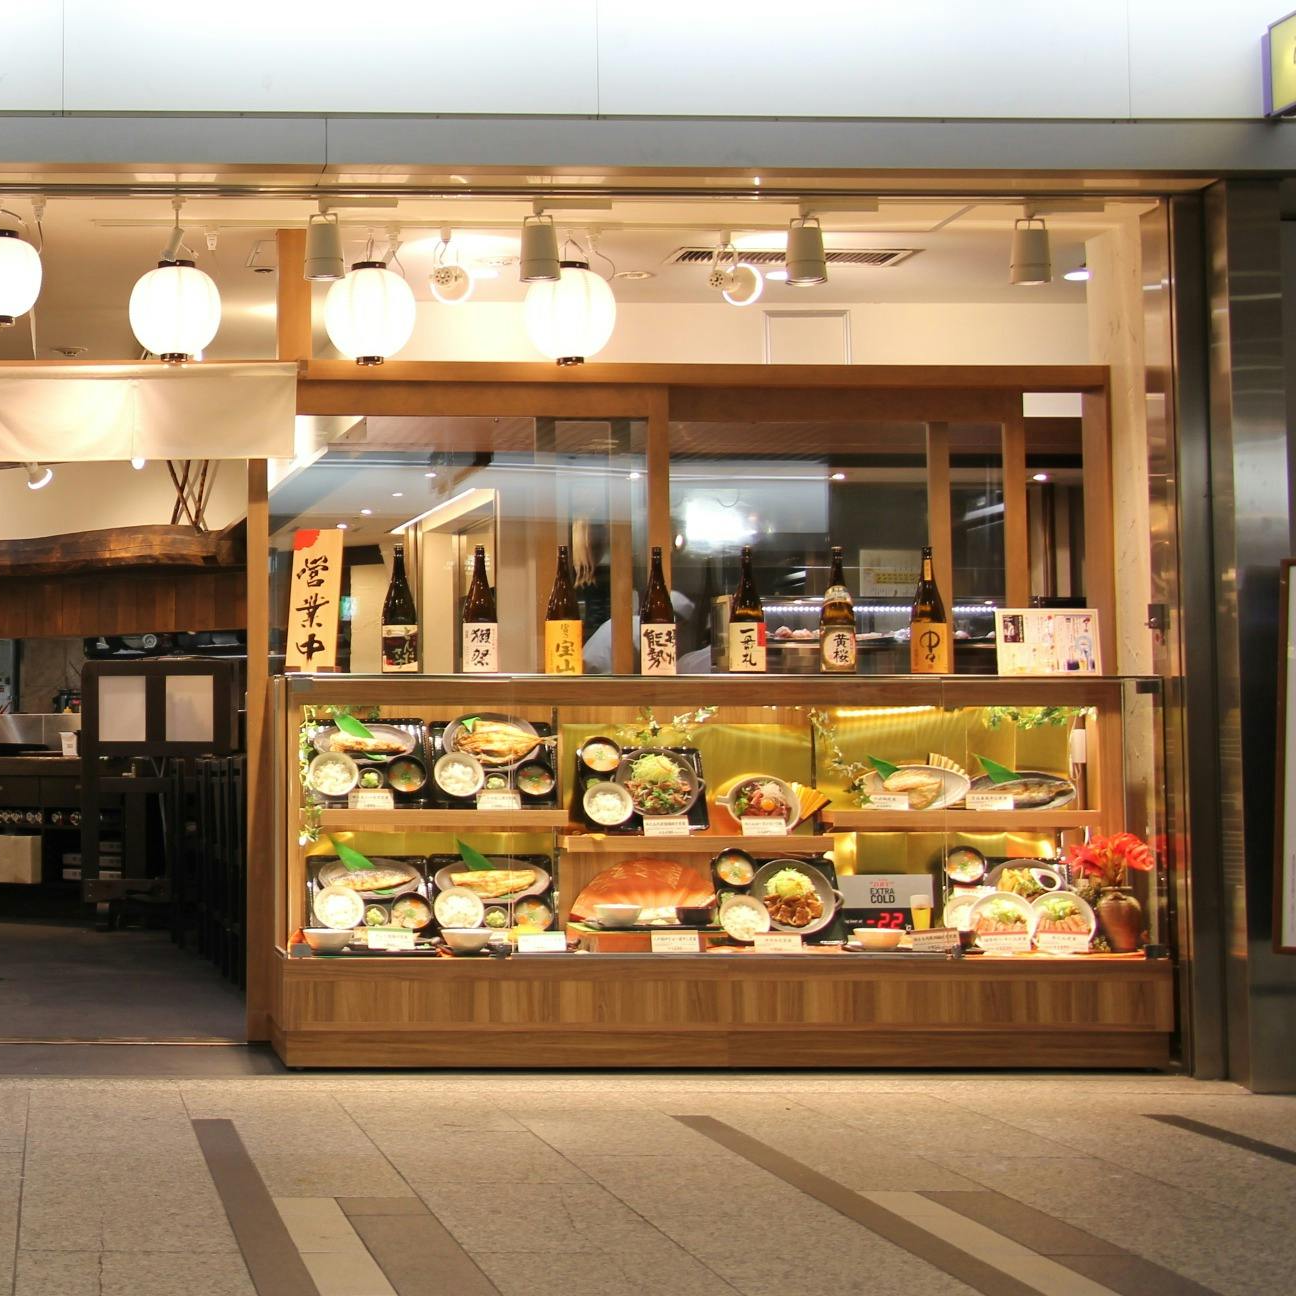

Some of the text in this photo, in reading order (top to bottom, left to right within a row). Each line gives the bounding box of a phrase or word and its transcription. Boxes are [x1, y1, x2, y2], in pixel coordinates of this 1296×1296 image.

[296, 555, 330, 661] 営業中
[870, 895, 895, 904] COLD
